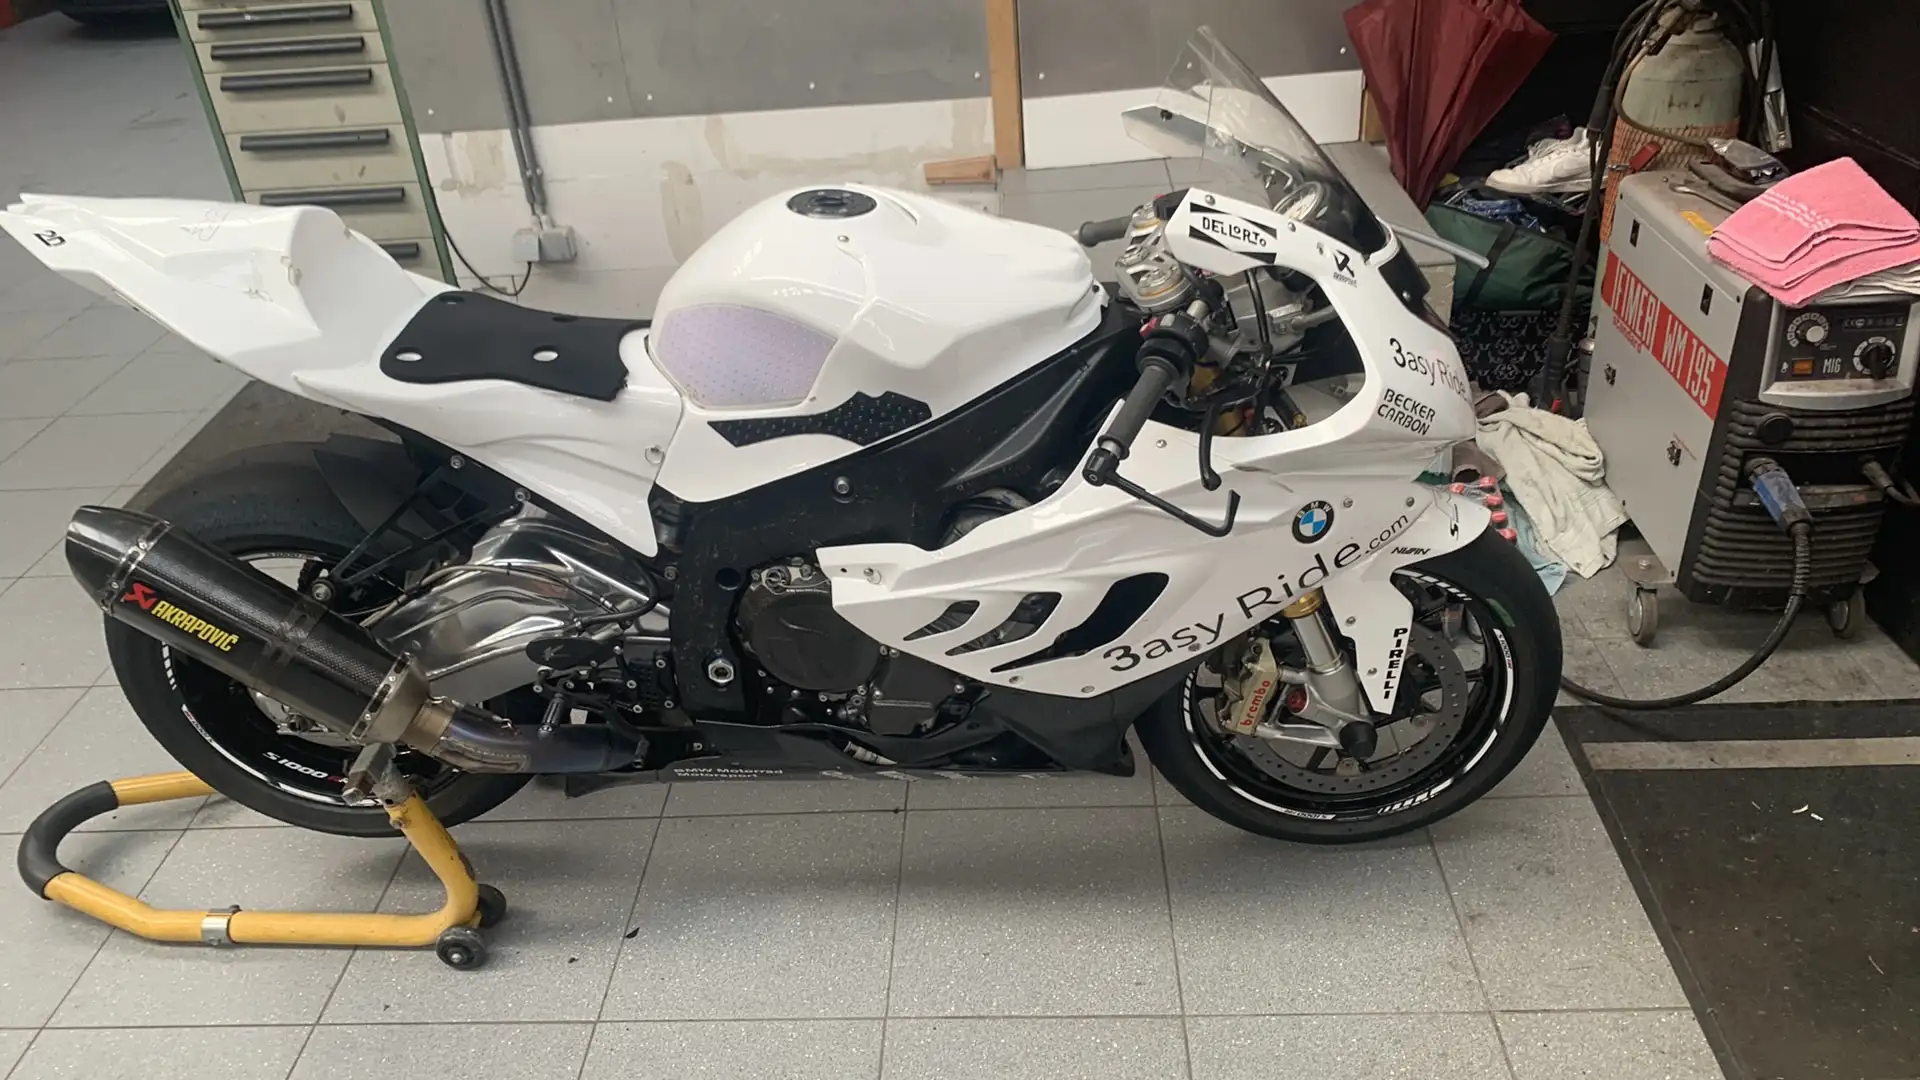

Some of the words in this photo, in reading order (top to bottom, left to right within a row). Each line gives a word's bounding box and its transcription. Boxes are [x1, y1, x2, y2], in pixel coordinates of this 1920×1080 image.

[1613, 262, 1659, 351] FIMER
[1661, 313, 1689, 380] WM
[1685, 337, 1717, 407] 195
[1389, 338, 1436, 386] 3asy
[1823, 358, 1842, 373] MIG
[1377, 404, 1430, 436] CARBON
[1383, 388, 1436, 422] BECKER
[1297, 501, 1331, 518] BMW
[1103, 613, 1224, 671] 3asy
[1383, 627, 1408, 700] PIRELLI
[1240, 680, 1271, 726] brembo
